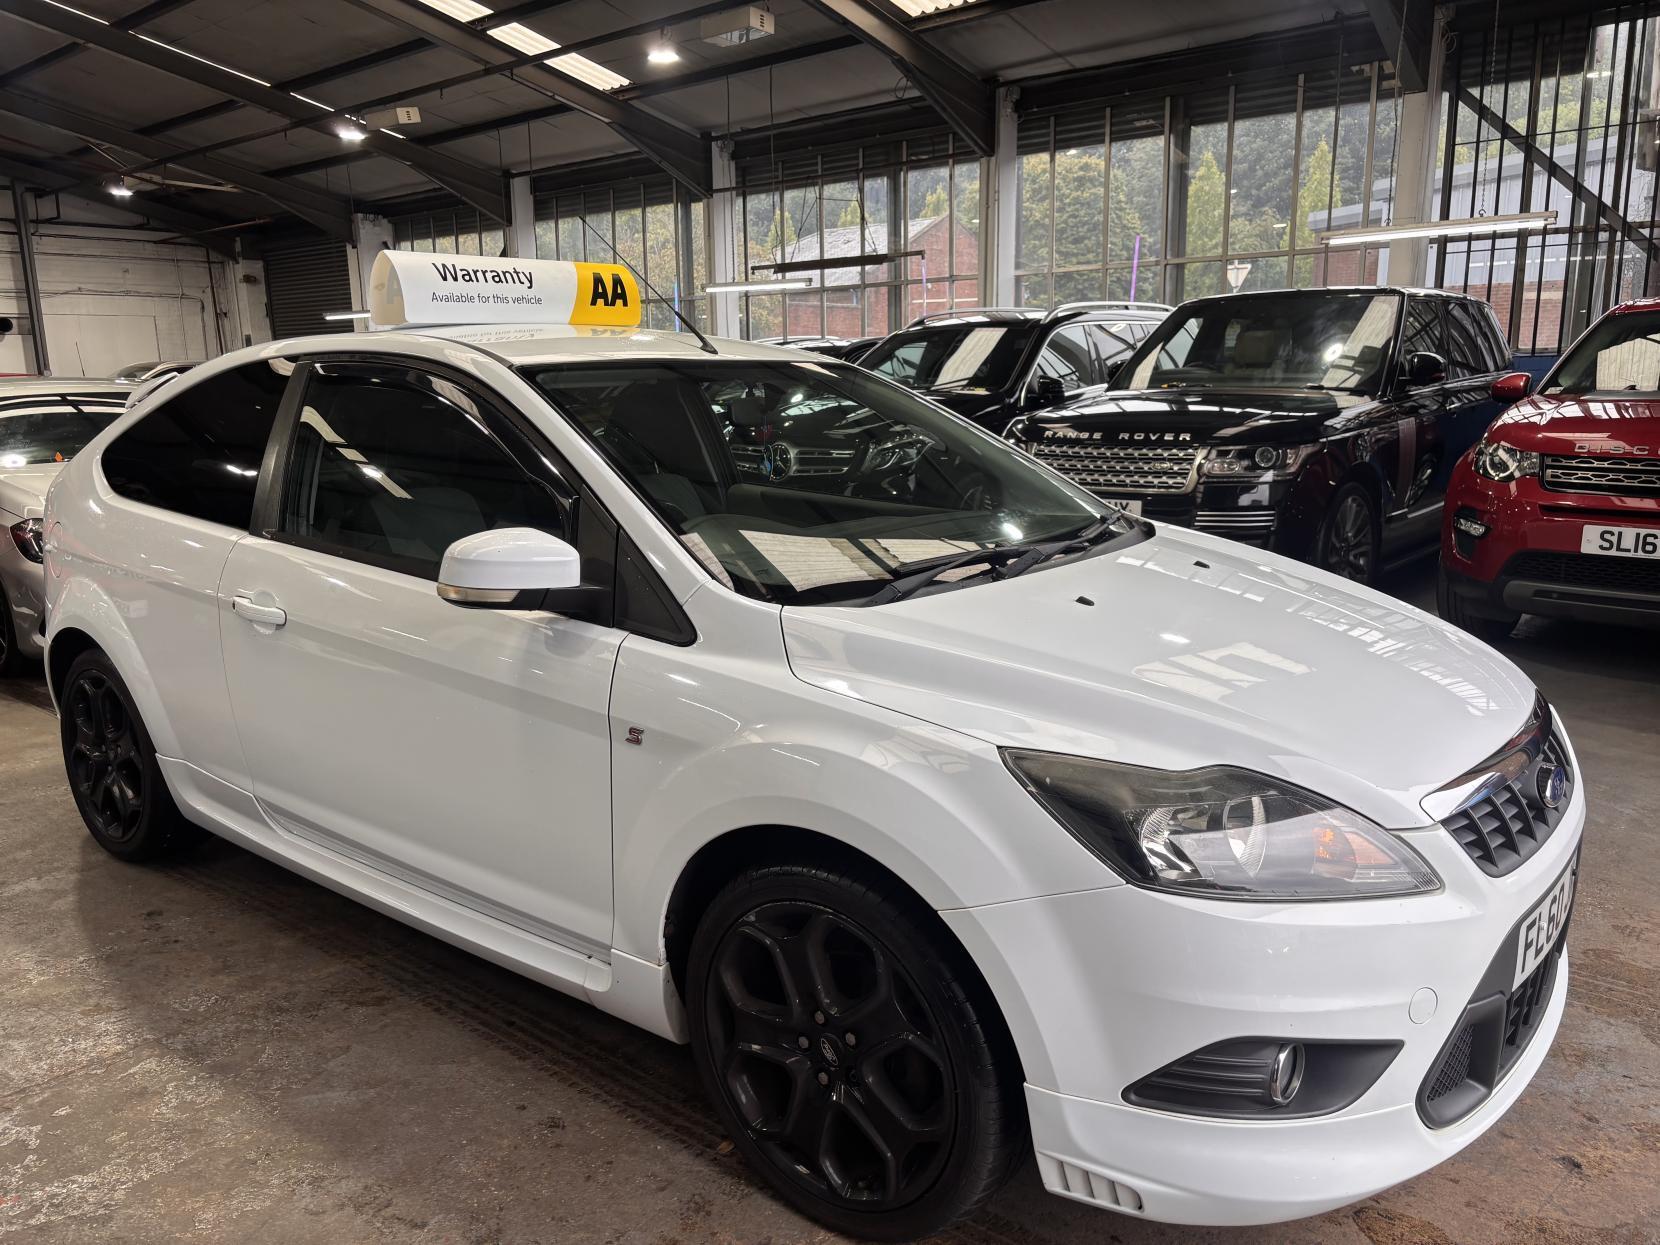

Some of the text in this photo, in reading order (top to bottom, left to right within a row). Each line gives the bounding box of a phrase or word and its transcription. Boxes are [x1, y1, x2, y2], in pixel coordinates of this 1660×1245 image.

[431, 262, 533, 289] Warranty
[431, 292, 543, 305] Available for this vehicle
[590, 272, 628, 307] AA
[1043, 430, 1191, 441] RANGE ROVER
[1574, 443, 1660, 455] DISC
[1598, 529, 1659, 555] SL16
